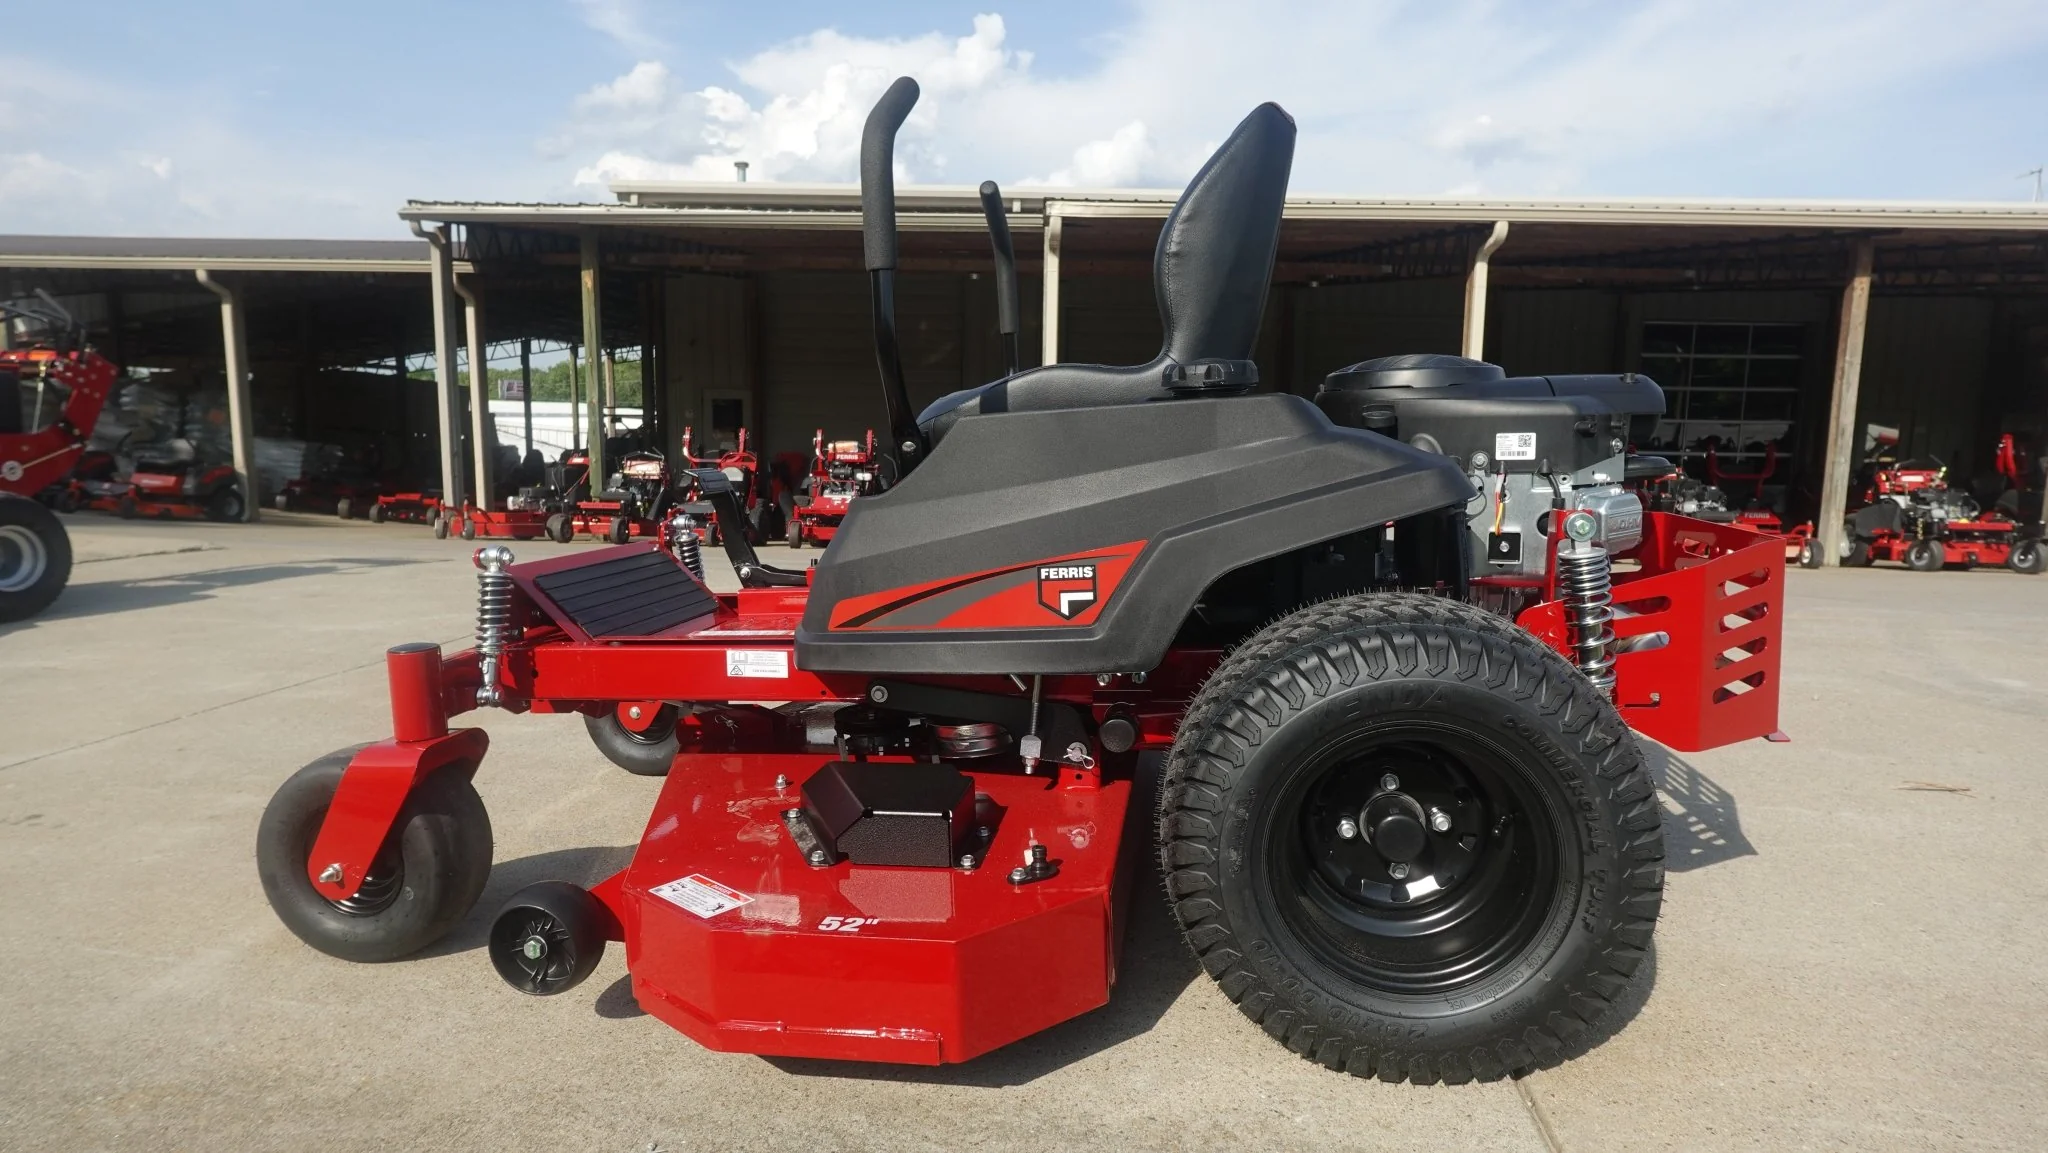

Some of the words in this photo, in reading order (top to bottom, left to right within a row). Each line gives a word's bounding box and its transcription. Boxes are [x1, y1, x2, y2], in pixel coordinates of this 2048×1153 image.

[1040, 566, 1094, 579] FERRIS
[1503, 714, 1610, 854] COMMERCIAL
[817, 916, 880, 932] 52"
[1525, 953, 1543, 970] FOR
[1475, 970, 1525, 1003] COMMERCIAL
[1449, 1000, 1467, 1011] USE
